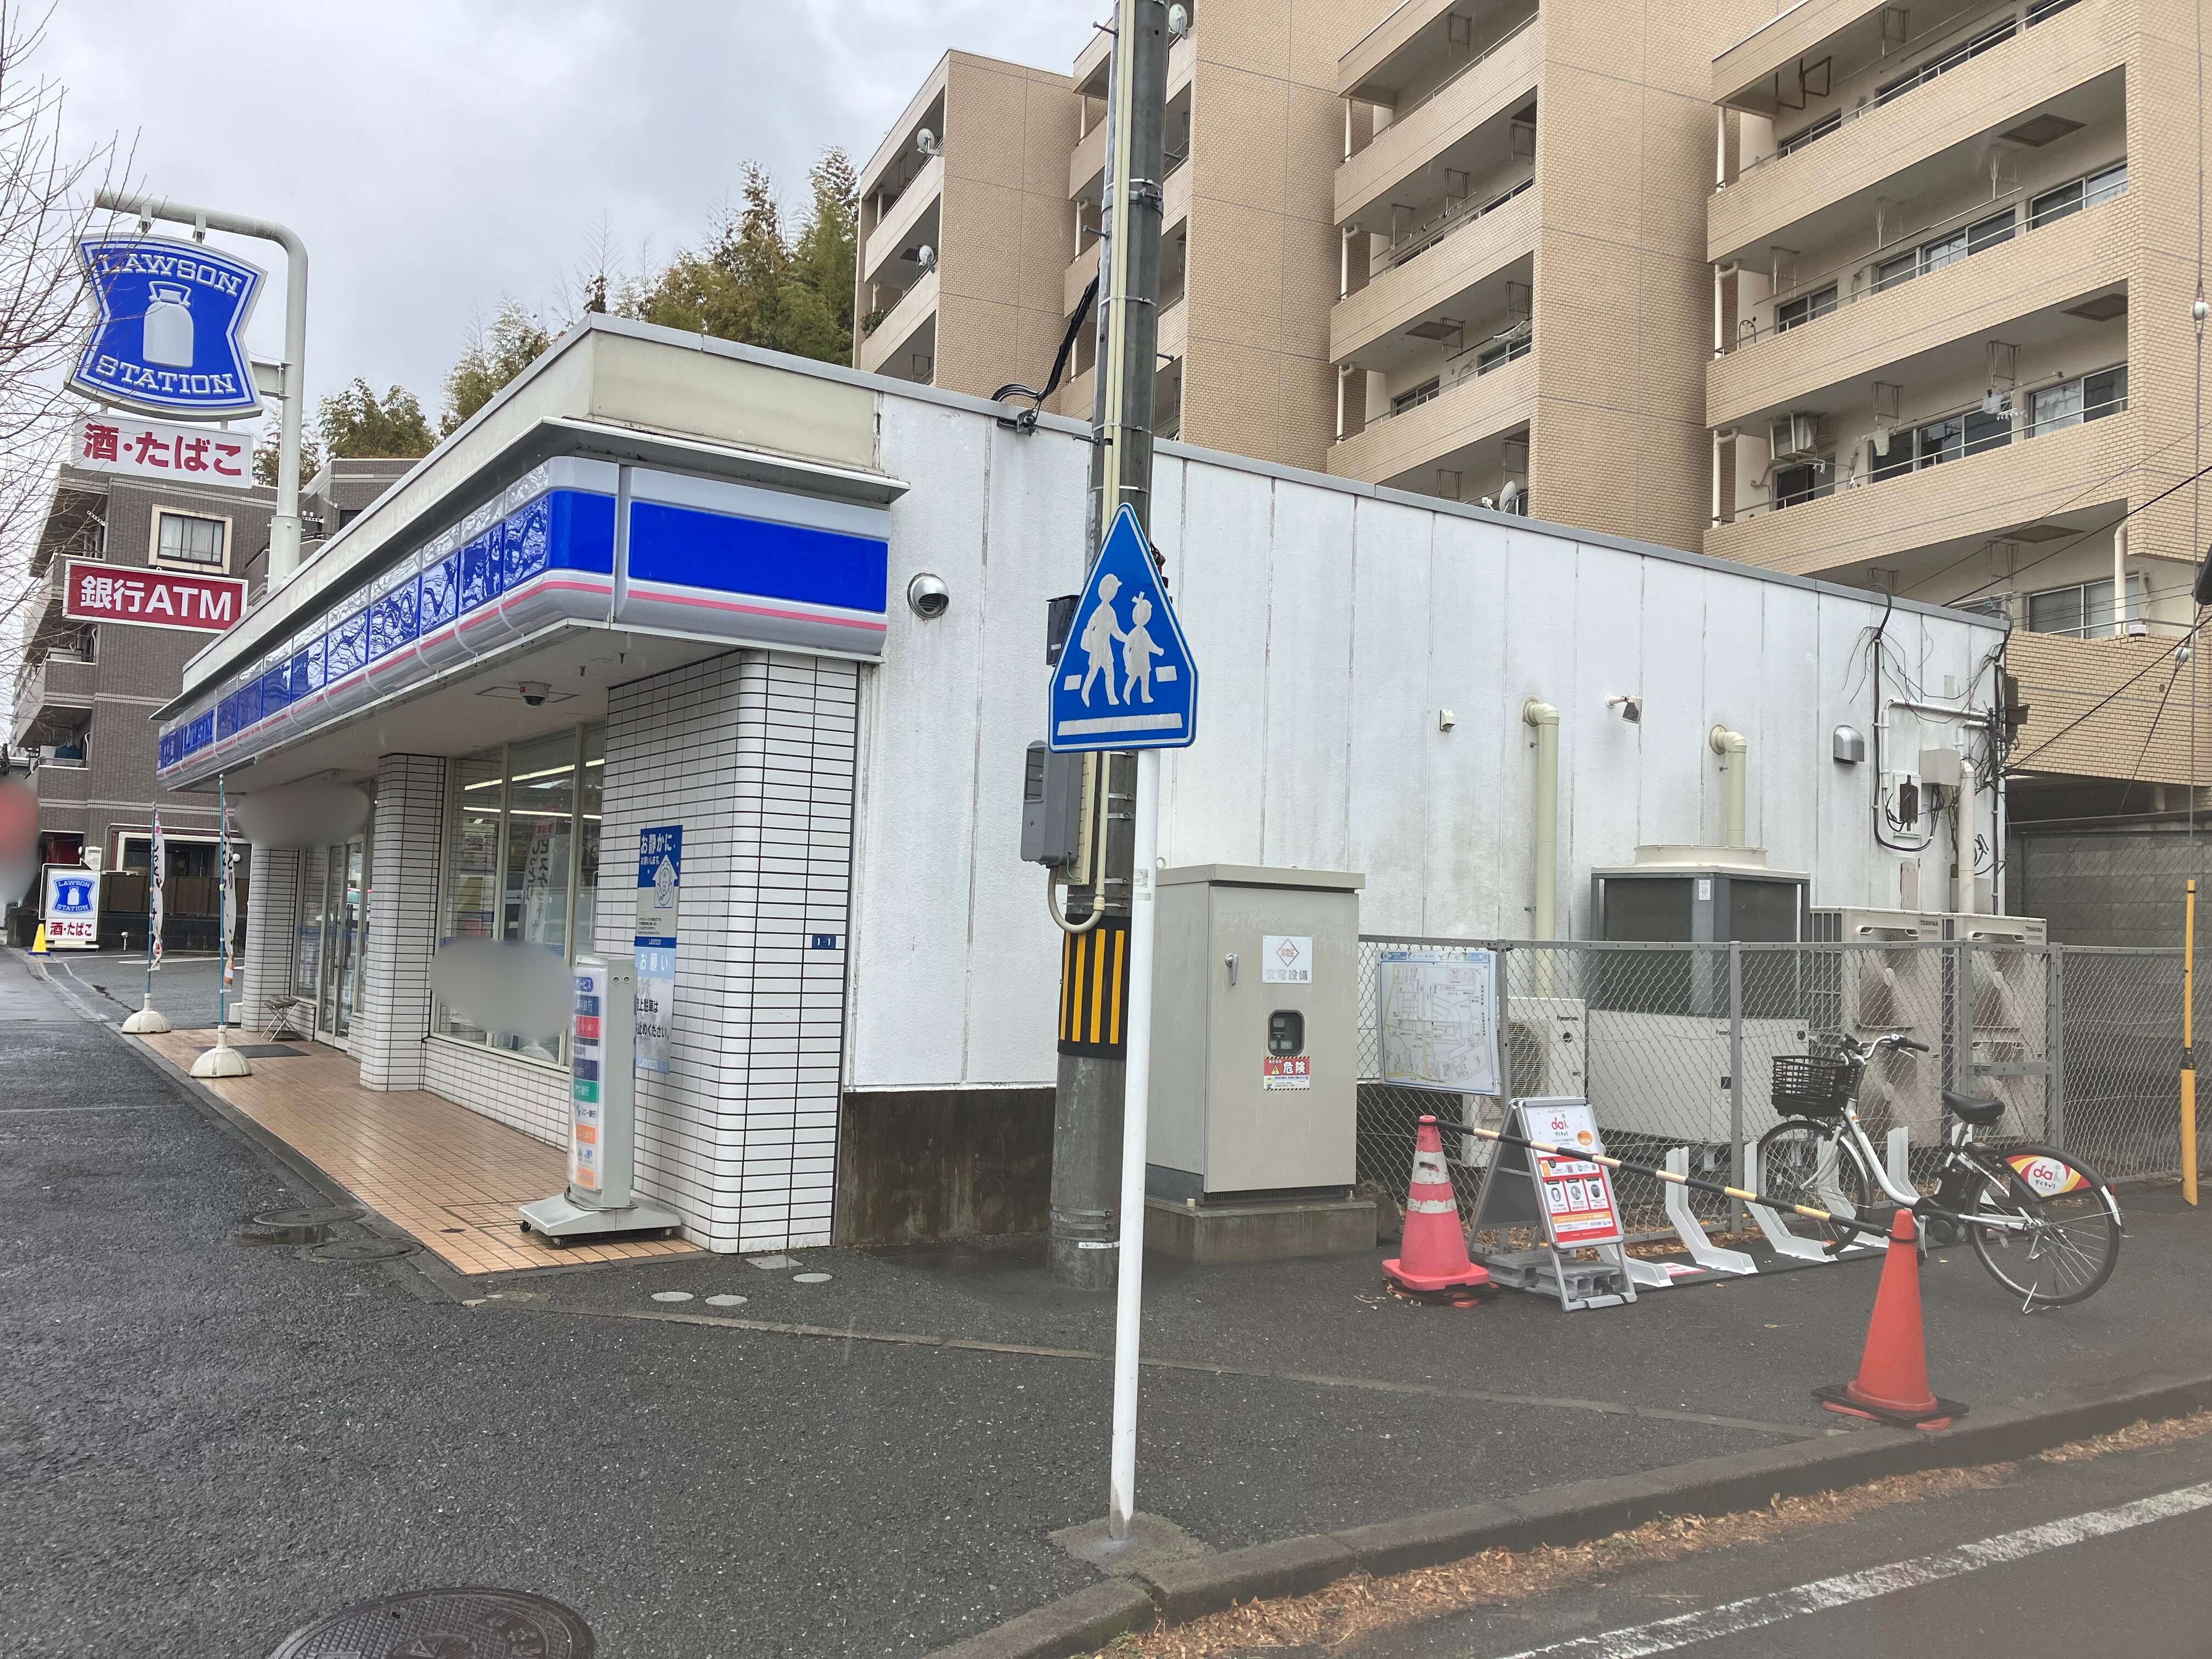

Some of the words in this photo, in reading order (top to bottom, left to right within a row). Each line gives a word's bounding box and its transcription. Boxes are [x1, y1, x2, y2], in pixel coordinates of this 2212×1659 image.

[98, 253, 242, 297] LAWSON
[95, 354, 236, 394] STATION
[83, 422, 242, 476] 酒・たばこ
[80, 574, 232, 622] 銀行ATM
[640, 833, 673, 854] お静かに
[49, 922, 92, 936] 酒・たばこ
[636, 1022, 669, 1040] 止めください。
[1283, 1060, 1306, 1074] 危険
[2035, 1180, 2056, 1189] ダイチャリ
